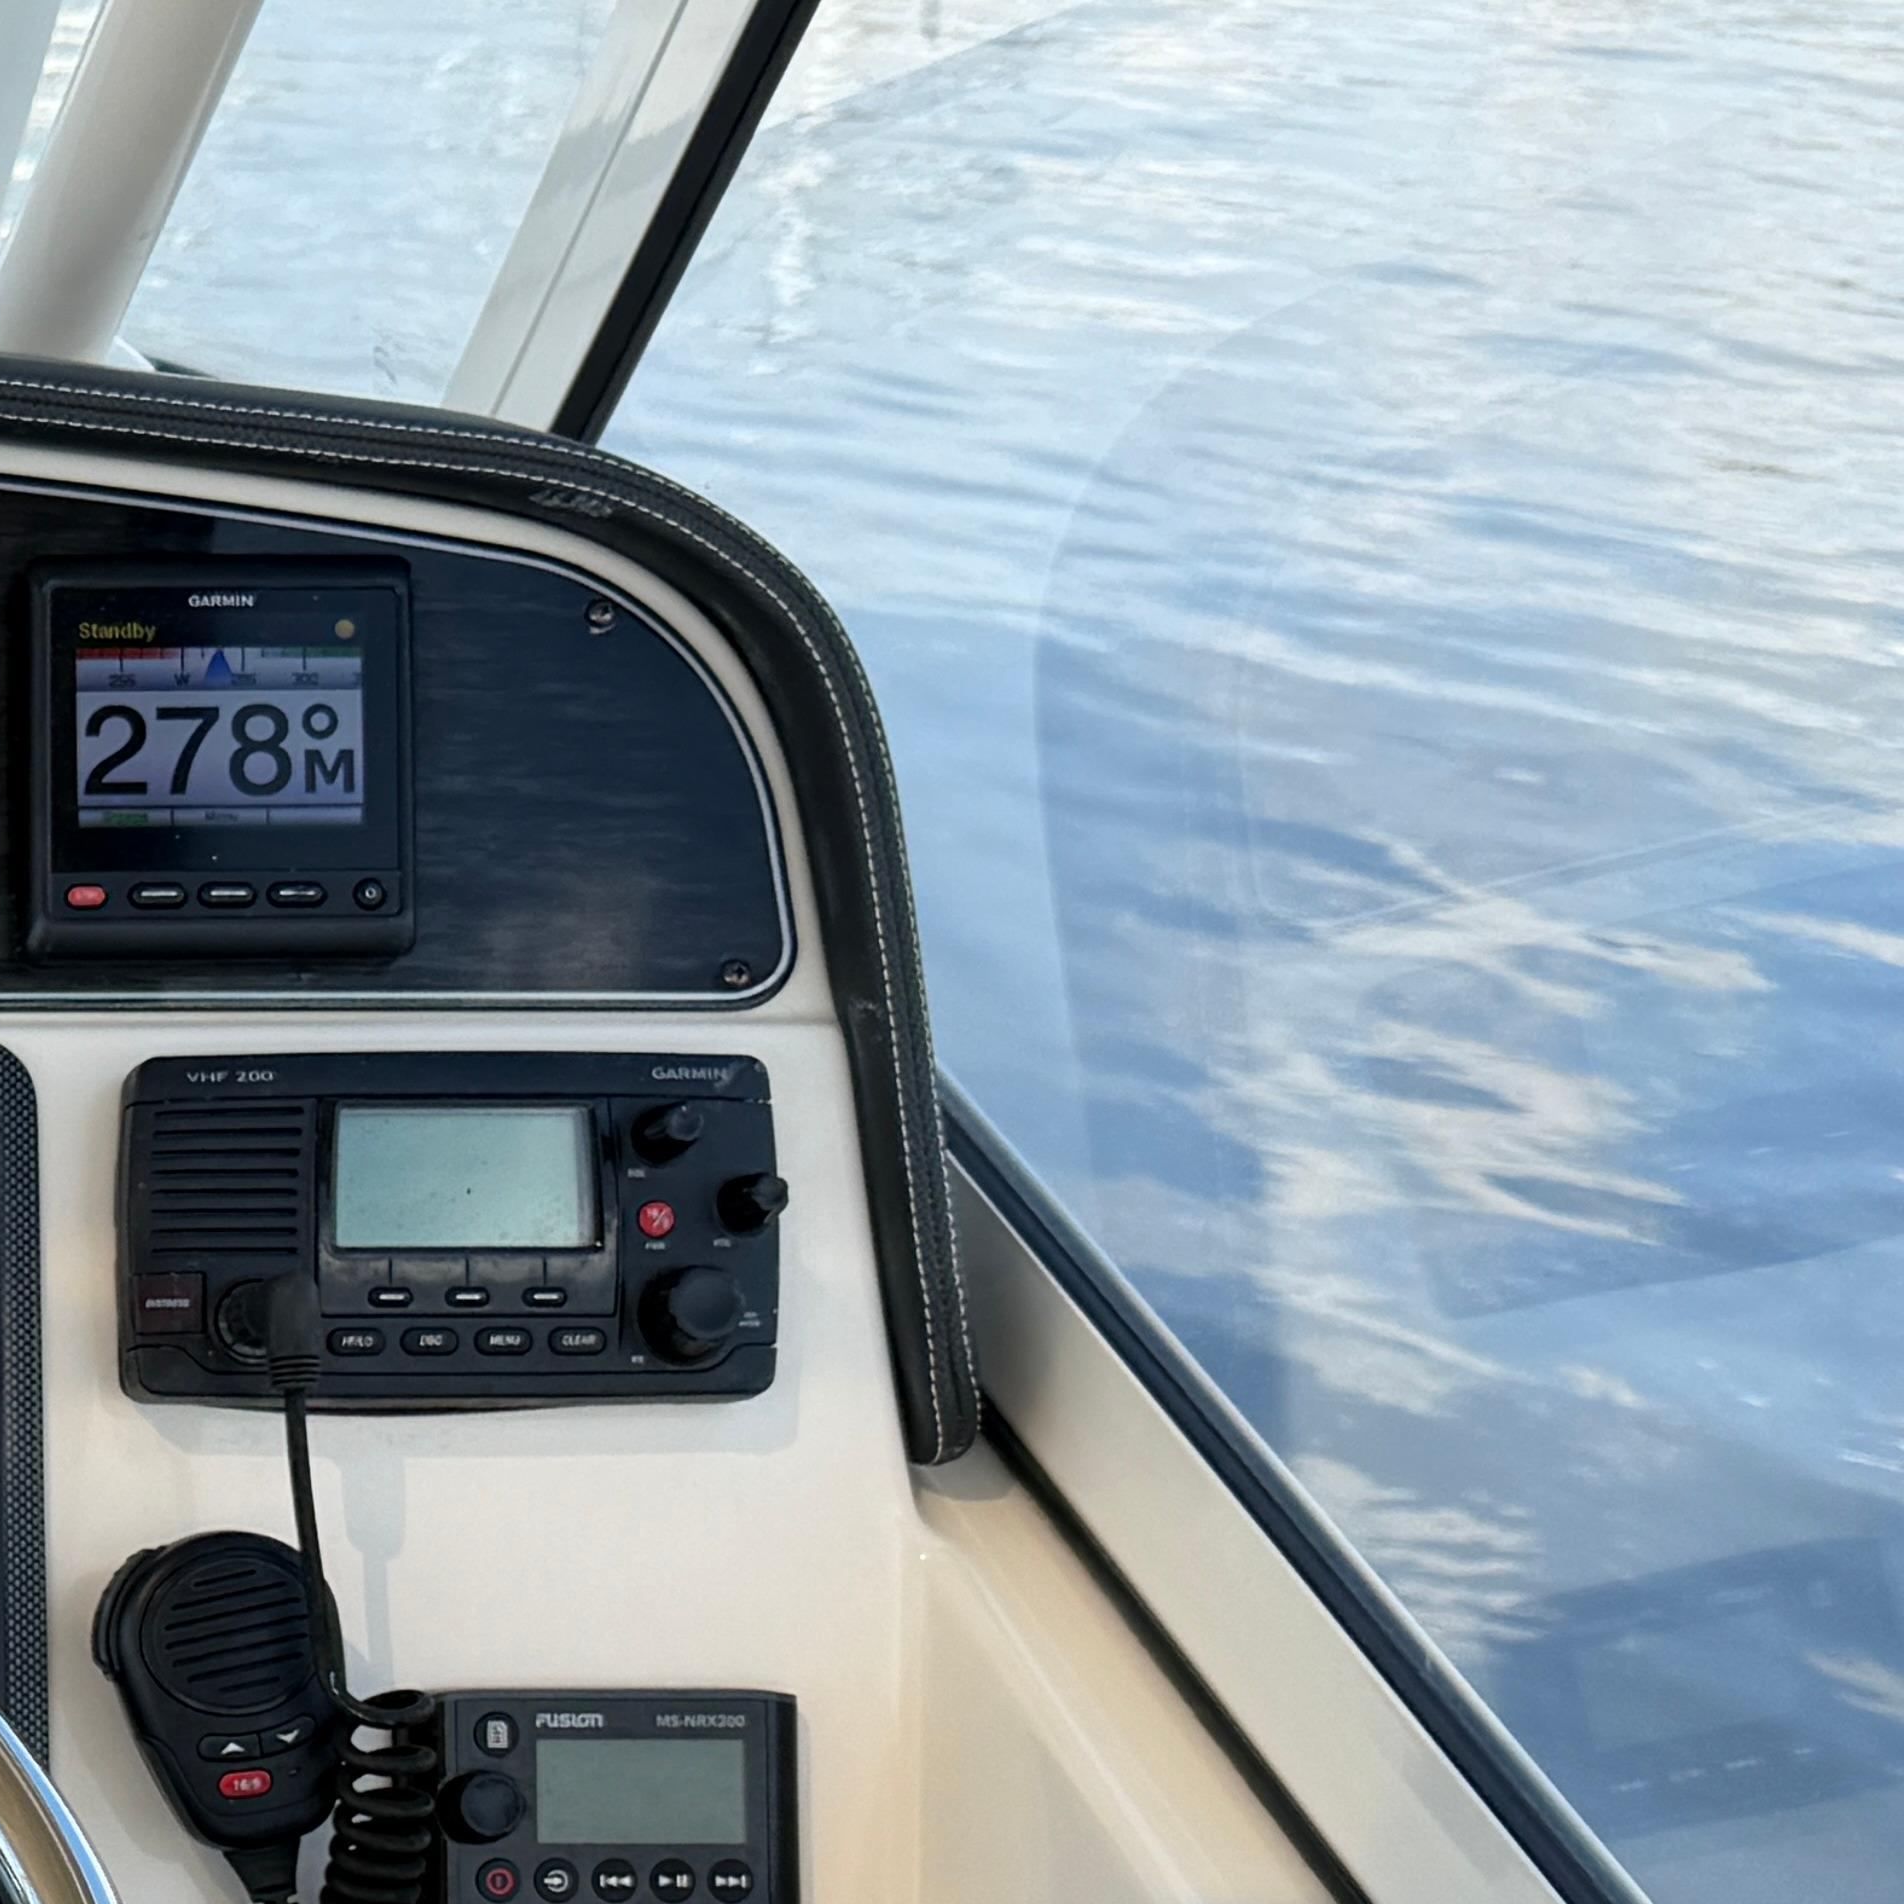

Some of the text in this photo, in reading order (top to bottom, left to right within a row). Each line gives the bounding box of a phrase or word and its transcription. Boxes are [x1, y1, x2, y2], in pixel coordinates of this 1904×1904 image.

[188, 594, 255, 608] GARMIN
[78, 621, 157, 642] Standby
[84, 703, 293, 797] 278
[186, 1071, 276, 1084] VHF 200
[651, 1067, 727, 1081] GARMIN
